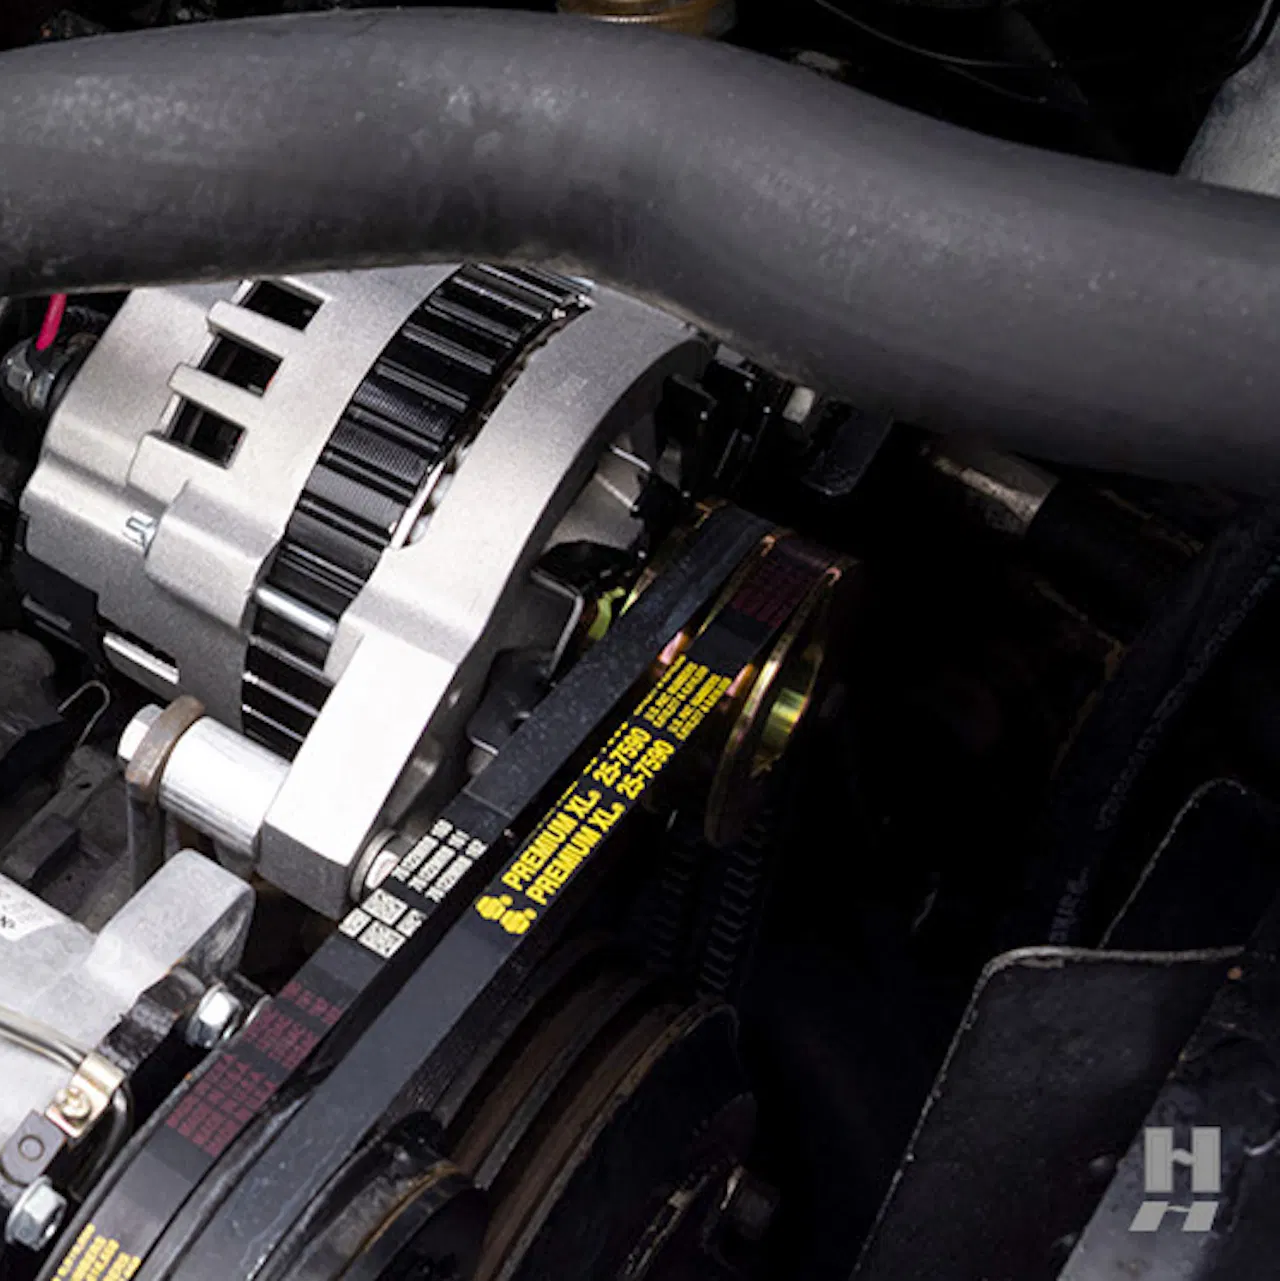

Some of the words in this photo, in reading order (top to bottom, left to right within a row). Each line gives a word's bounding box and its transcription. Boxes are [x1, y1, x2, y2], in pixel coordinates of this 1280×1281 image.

[502, 811, 578, 891] PREMIUM
[592, 727, 652, 787] 25-7590
[525, 824, 602, 905] PREMIUM
[616, 739, 675, 800] 25-7590
